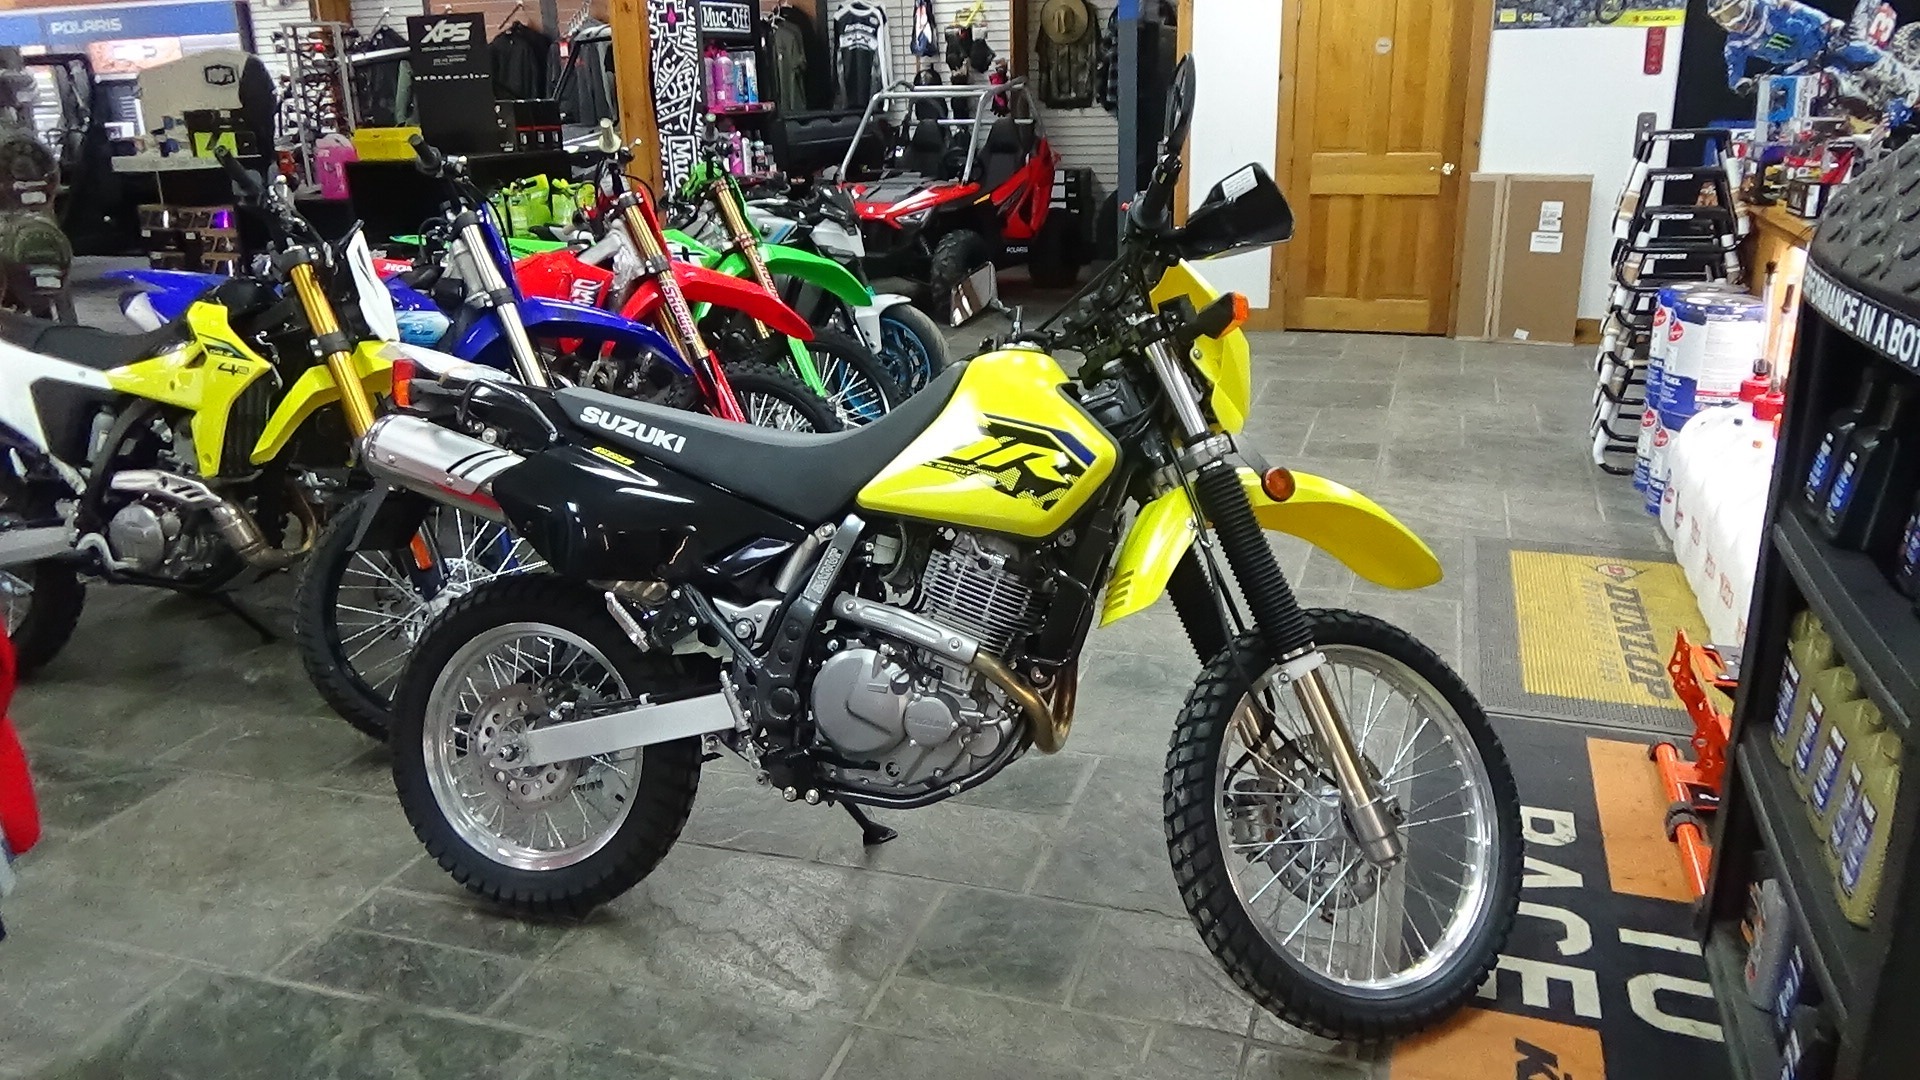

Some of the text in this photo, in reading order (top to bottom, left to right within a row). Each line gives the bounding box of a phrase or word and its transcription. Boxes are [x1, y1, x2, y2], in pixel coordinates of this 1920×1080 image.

[50, 17, 122, 35] POLARIS
[421, 20, 472, 44] XPS
[702, 6, 750, 29] Muc-Off
[1856, 302, 1878, 342] IN
[1872, 312, 1890, 350] A
[580, 406, 687, 454] SUZUKI
[1603, 581, 1674, 700] DUNLOP
